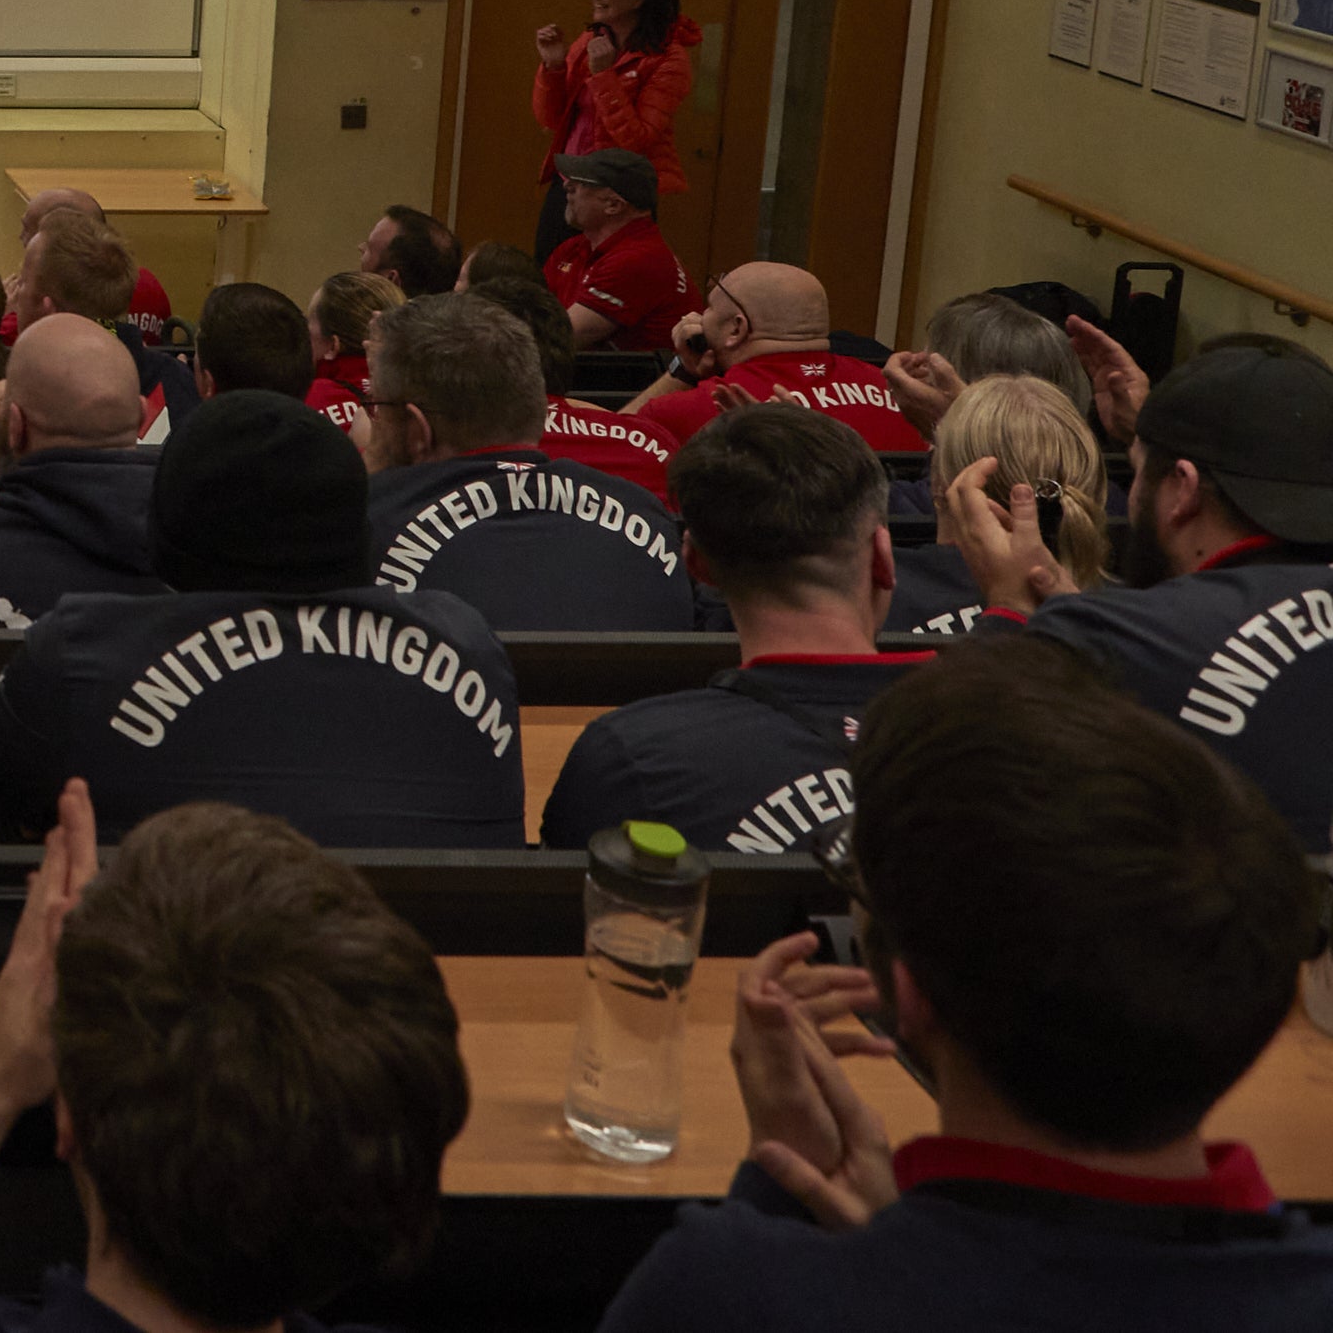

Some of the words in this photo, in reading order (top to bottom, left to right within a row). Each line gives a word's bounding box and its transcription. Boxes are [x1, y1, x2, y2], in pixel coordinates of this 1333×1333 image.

[544, 411, 670, 464] KINGDOM
[375, 480, 498, 594] UNITED
[506, 471, 679, 578] KINGDOM
[110, 608, 284, 749] UNITED
[296, 604, 516, 759] KINGDOM
[1179, 589, 1333, 736] UNITED
